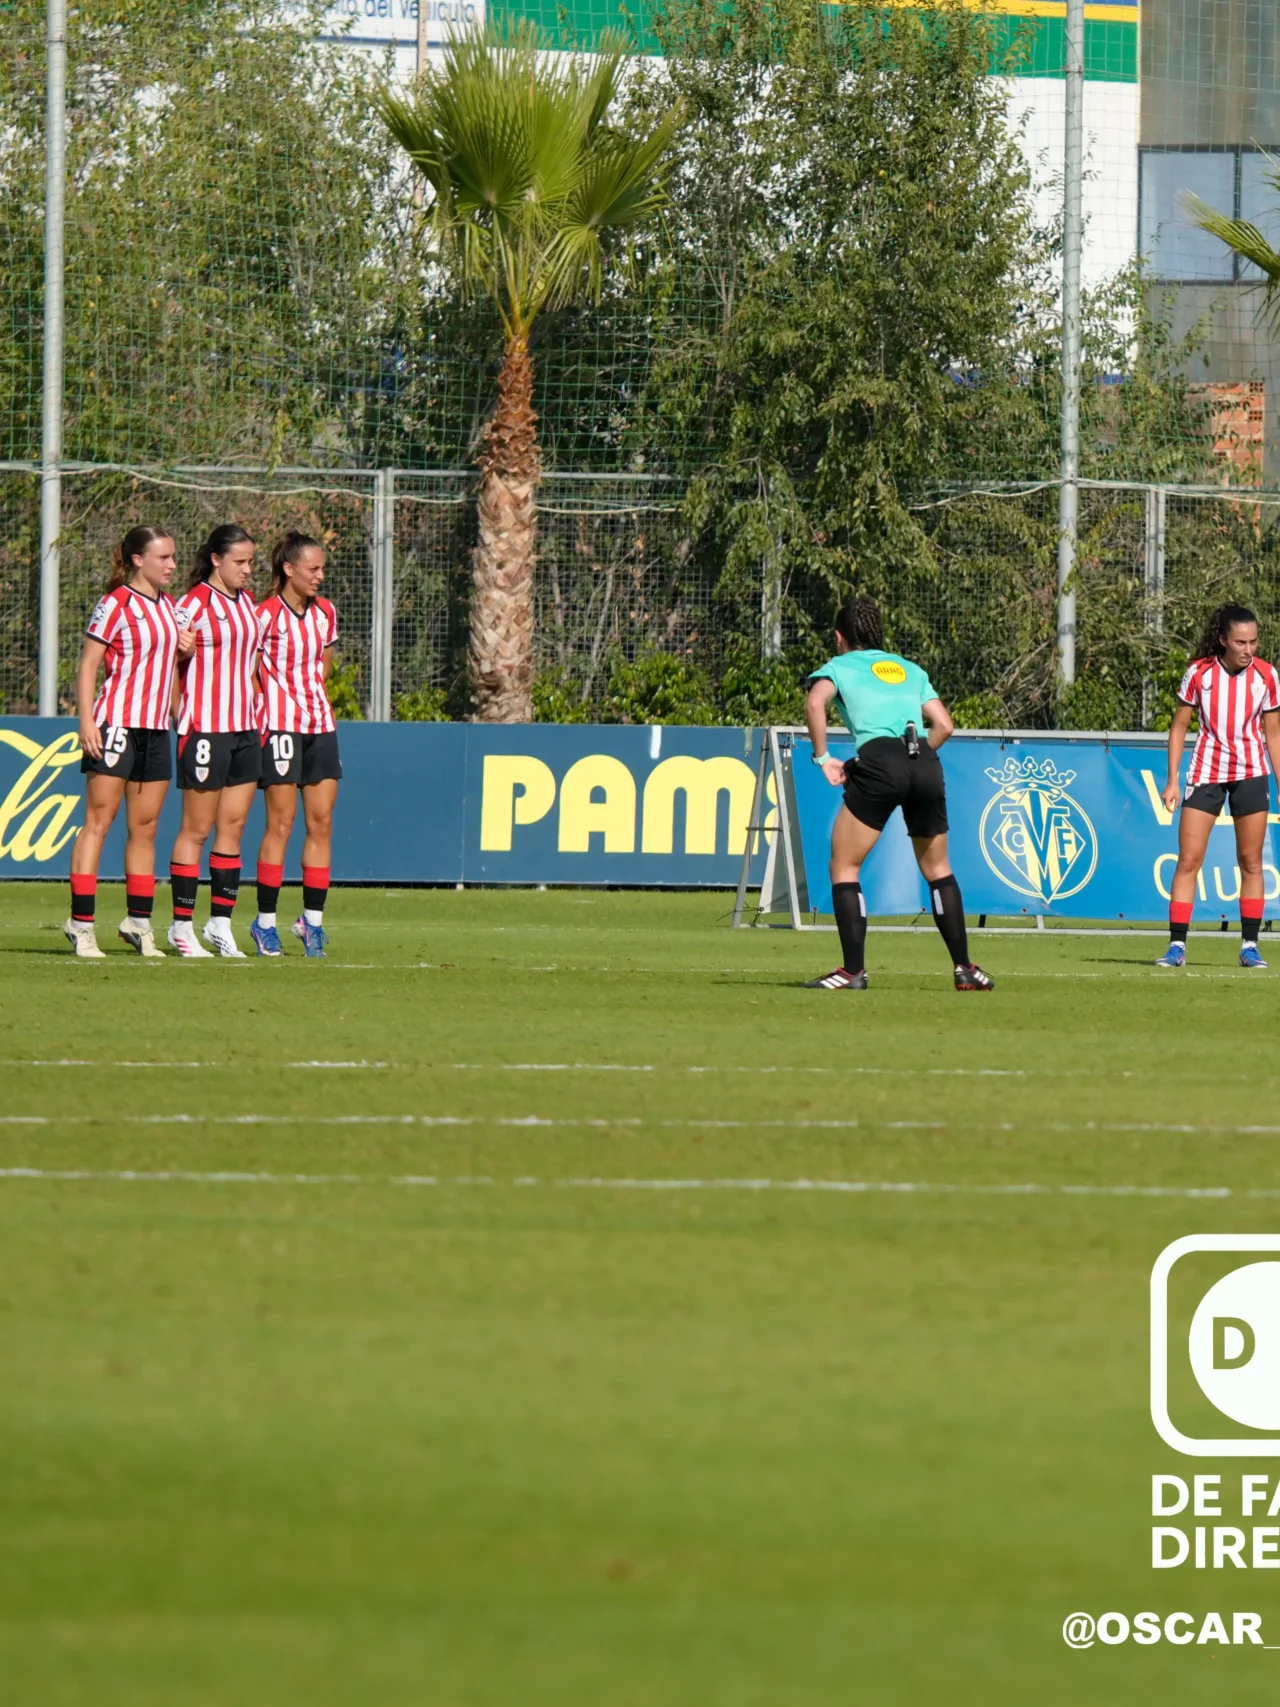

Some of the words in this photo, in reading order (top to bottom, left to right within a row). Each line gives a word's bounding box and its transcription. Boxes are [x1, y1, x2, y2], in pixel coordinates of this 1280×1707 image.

[876, 667, 903, 676] ARAG
[104, 727, 128, 753] 15
[195, 739, 211, 765] 8
[269, 735, 294, 760] 10
[481, 754, 778, 855] PAM
